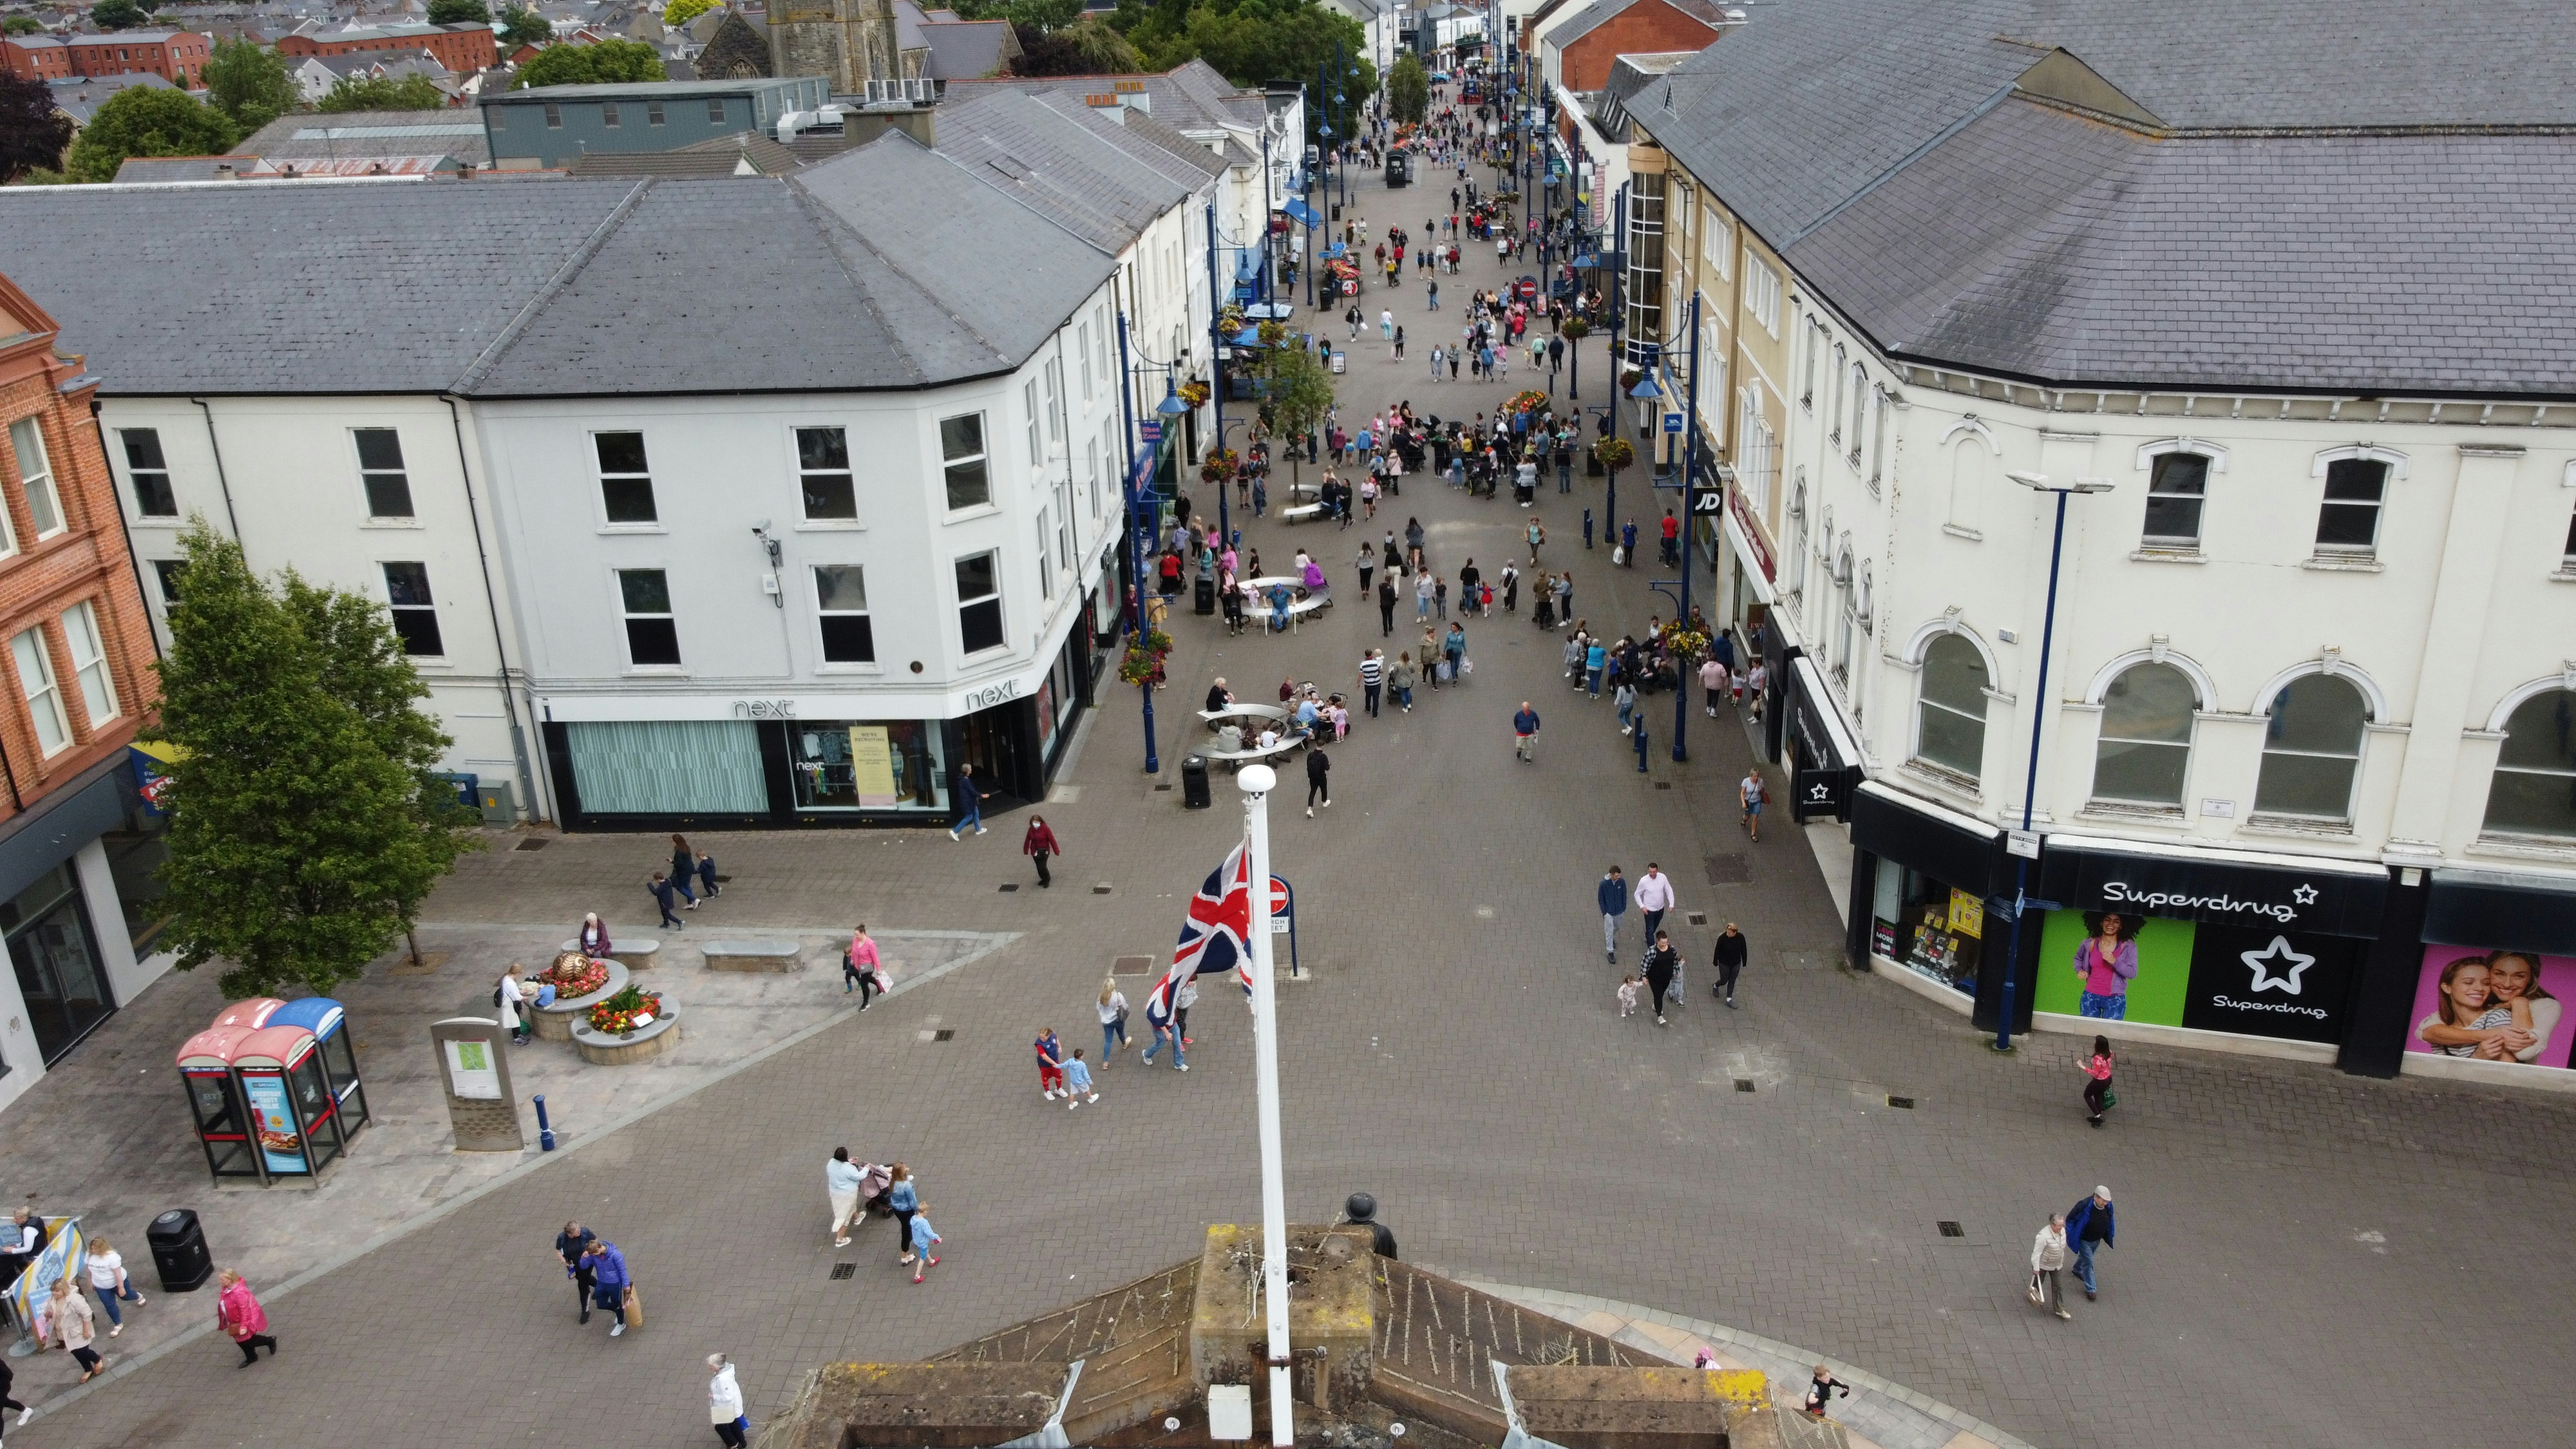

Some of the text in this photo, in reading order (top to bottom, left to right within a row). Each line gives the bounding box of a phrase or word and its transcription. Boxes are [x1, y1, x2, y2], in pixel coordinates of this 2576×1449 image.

[1695, 493, 1720, 511] JD
[966, 679, 1021, 710] next
[734, 699, 796, 718] next
[796, 761, 826, 771] next
[2103, 882, 2298, 923] Superdrug
[1876, 931, 1894, 944] MORE
[2213, 995, 2329, 1019] Superdrug
